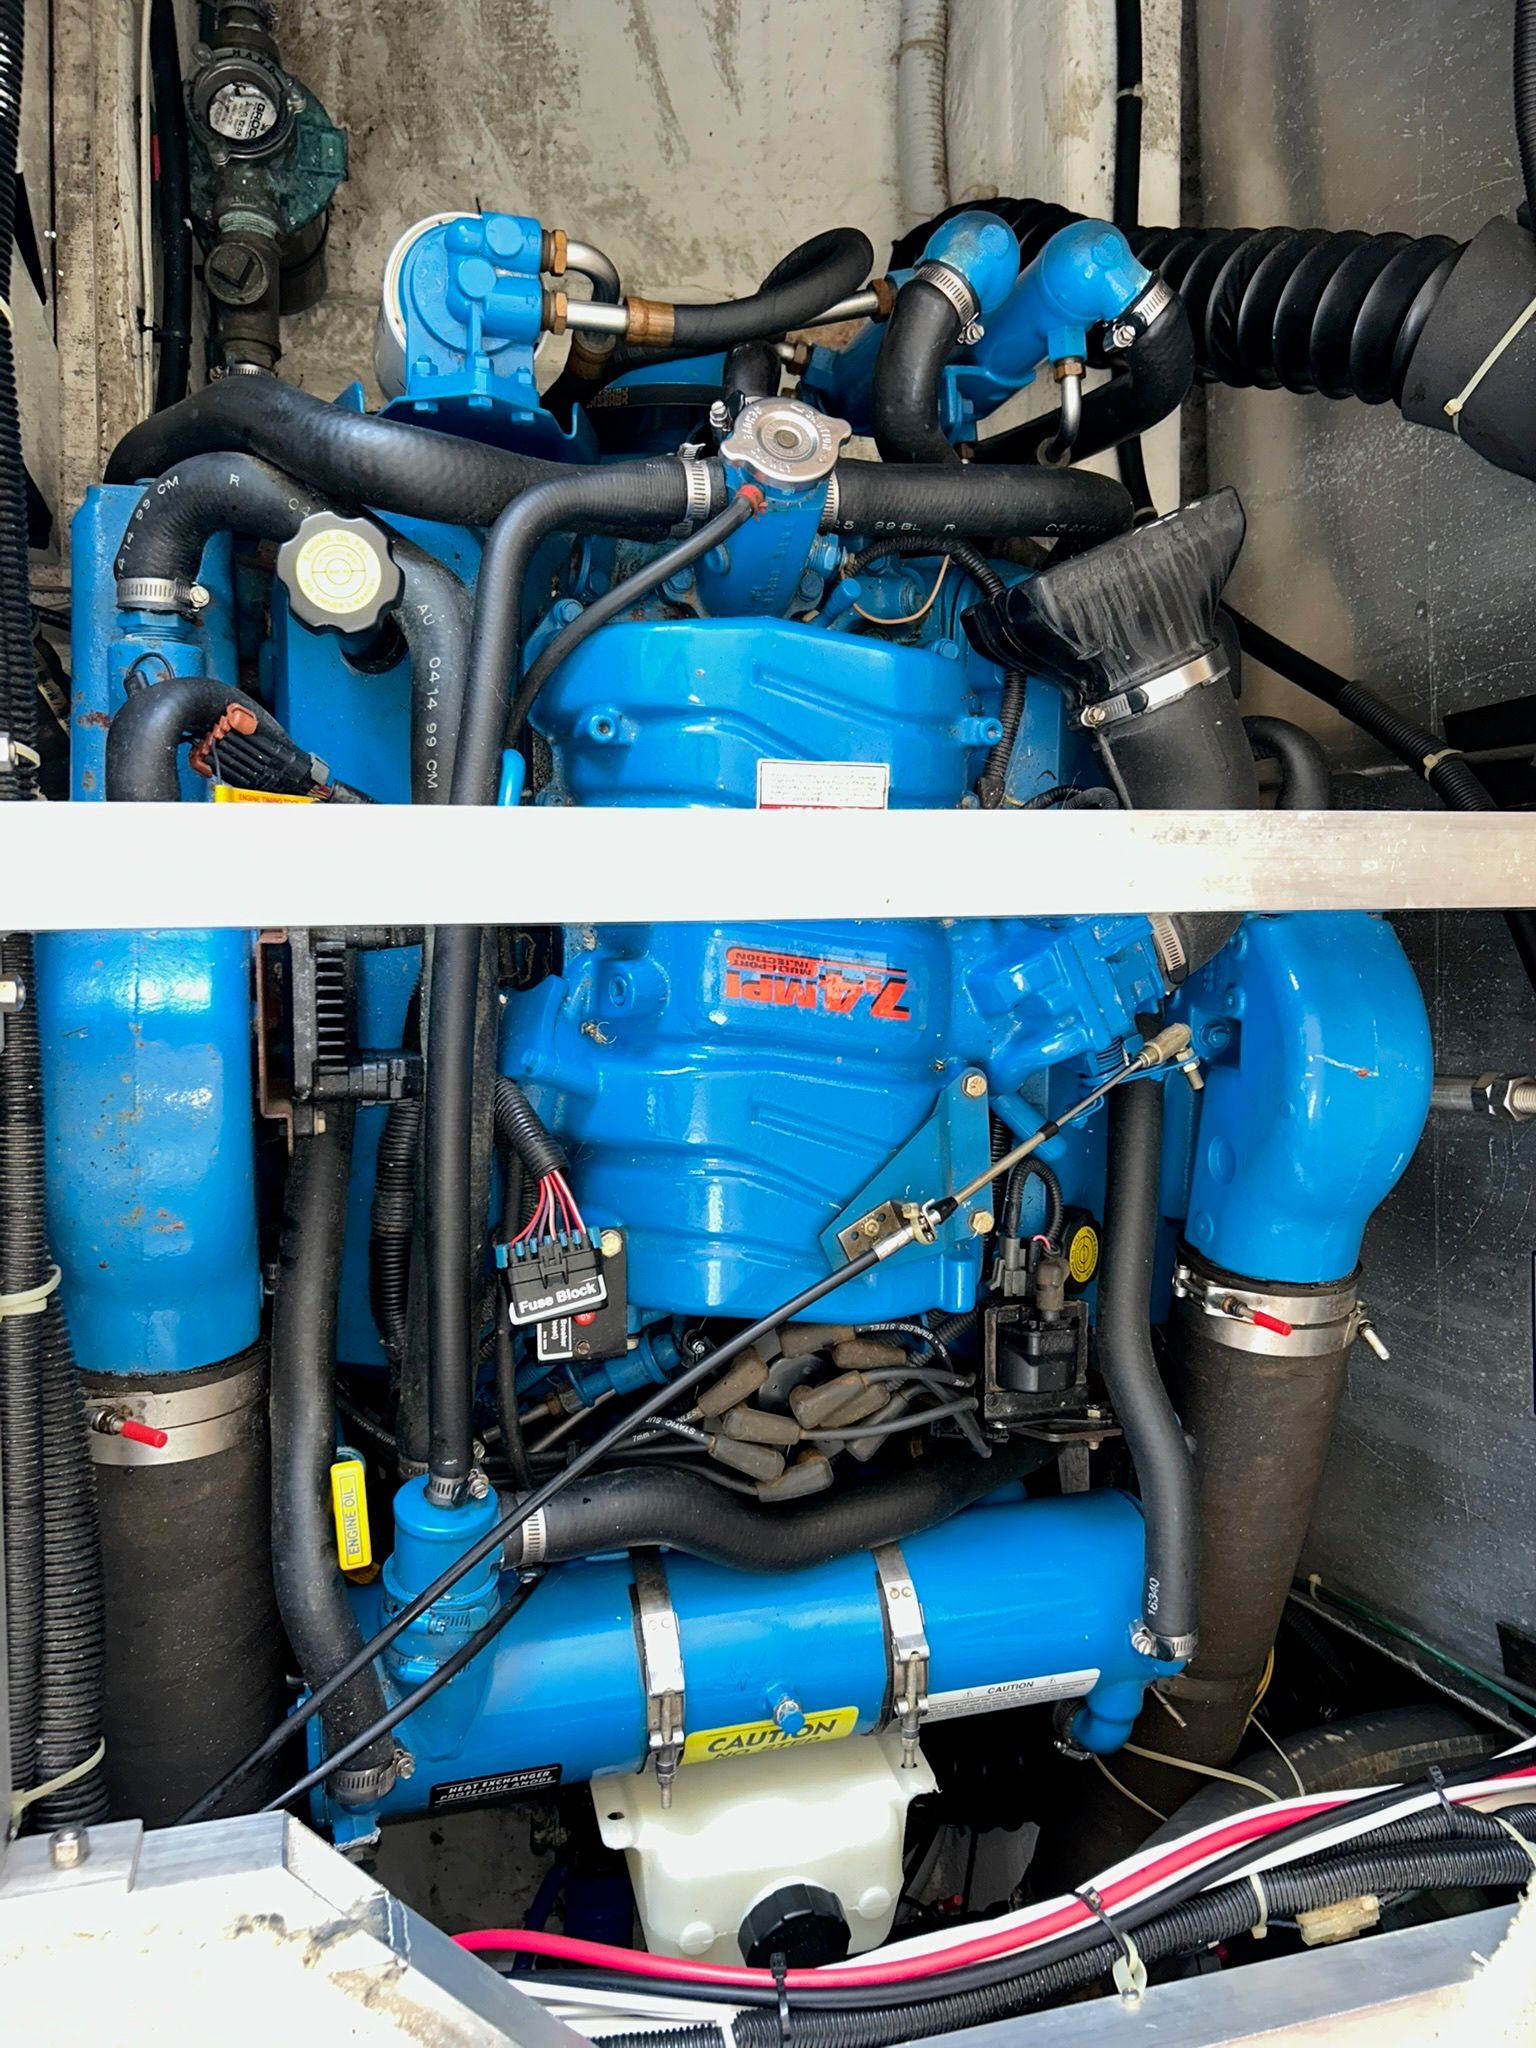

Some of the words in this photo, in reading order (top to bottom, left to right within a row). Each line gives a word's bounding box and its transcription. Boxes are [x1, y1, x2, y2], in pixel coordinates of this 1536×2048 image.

[248, 102, 266, 138] GROC
[135, 499, 151, 521] 99
[156, 475, 180, 495] CM
[228, 473, 240, 488] R
[426, 656, 441, 711] 0414
[426, 722, 437, 748] 99
[426, 759, 438, 789] CM
[731, 959, 812, 977] MULTI-PORT
[735, 952, 809, 968] INJECTION
[518, 1295, 554, 1314] Fuse
[555, 1282, 597, 1303] Block
[869, 1323, 896, 1331] STEEL
[898, 1323, 934, 1340] STAINLESS
[632, 1431, 650, 1442] 7mm
[665, 1419, 696, 1435] STATIC
[342, 1487, 355, 1508] OIL
[344, 1511, 360, 1555] ENGINE
[1147, 1577, 1160, 1616] 16340
[987, 1681, 1034, 1695] CAUTION
[440, 1784, 508, 1800] PROTECTIVE
[511, 1776, 553, 1788] ANODE
[448, 1783, 479, 1794] HEAT
[482, 1770, 551, 1788] EXCHANGER
